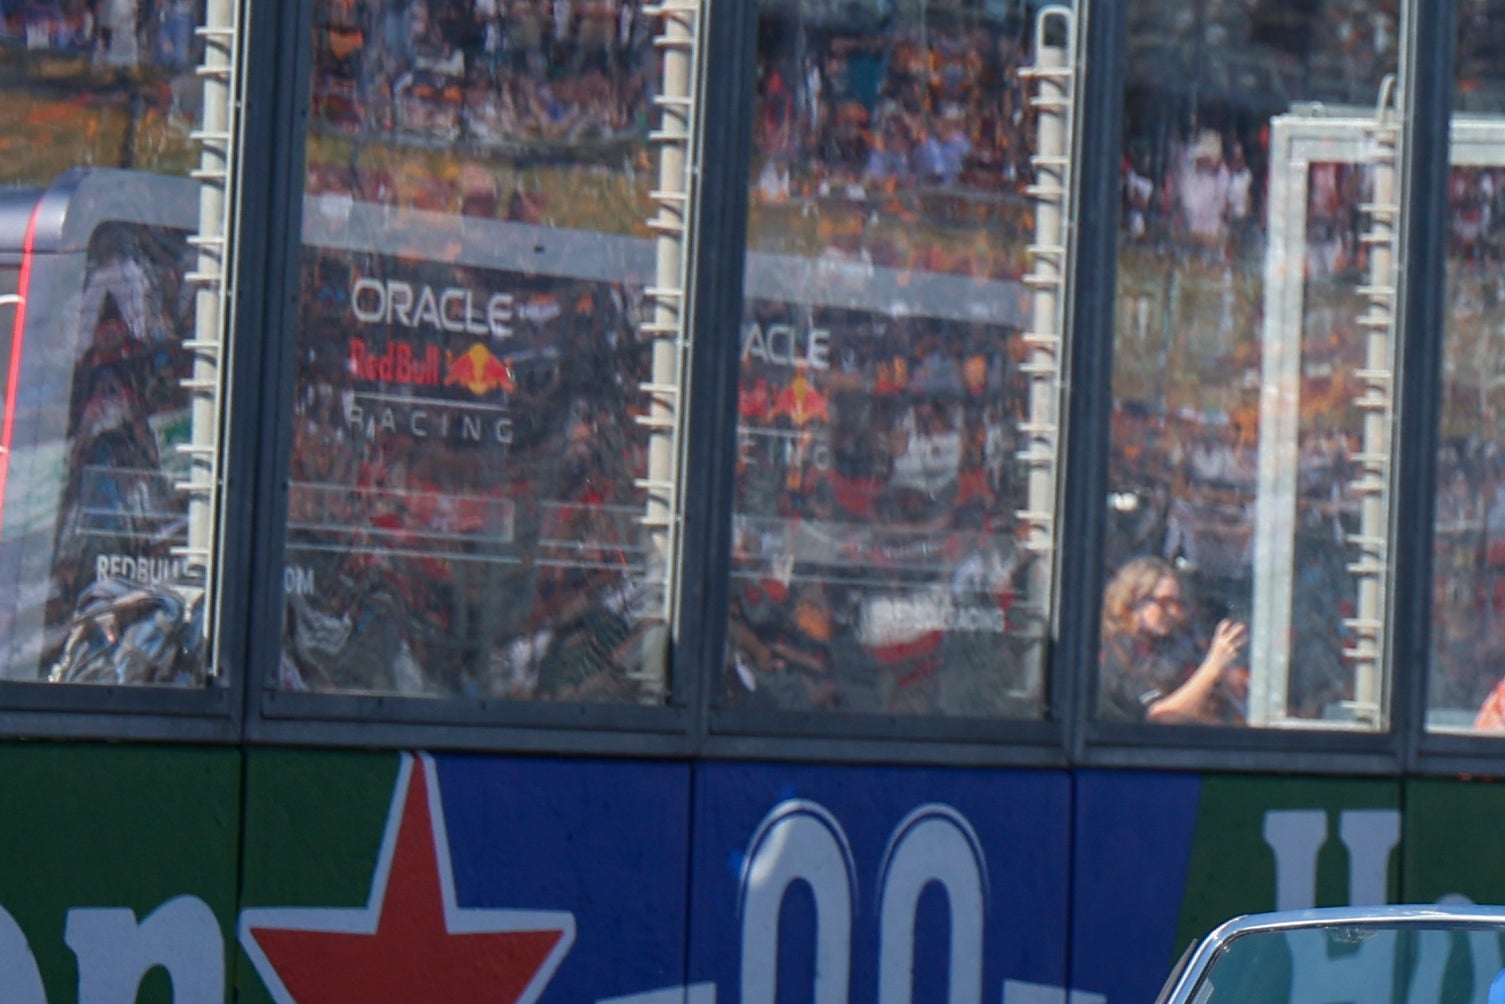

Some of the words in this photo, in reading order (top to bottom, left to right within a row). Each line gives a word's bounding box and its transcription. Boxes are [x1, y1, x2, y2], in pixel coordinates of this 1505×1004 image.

[352, 277, 514, 338] ORACLE
[740, 321, 831, 370] ACLE
[349, 405, 514, 444] RACING
